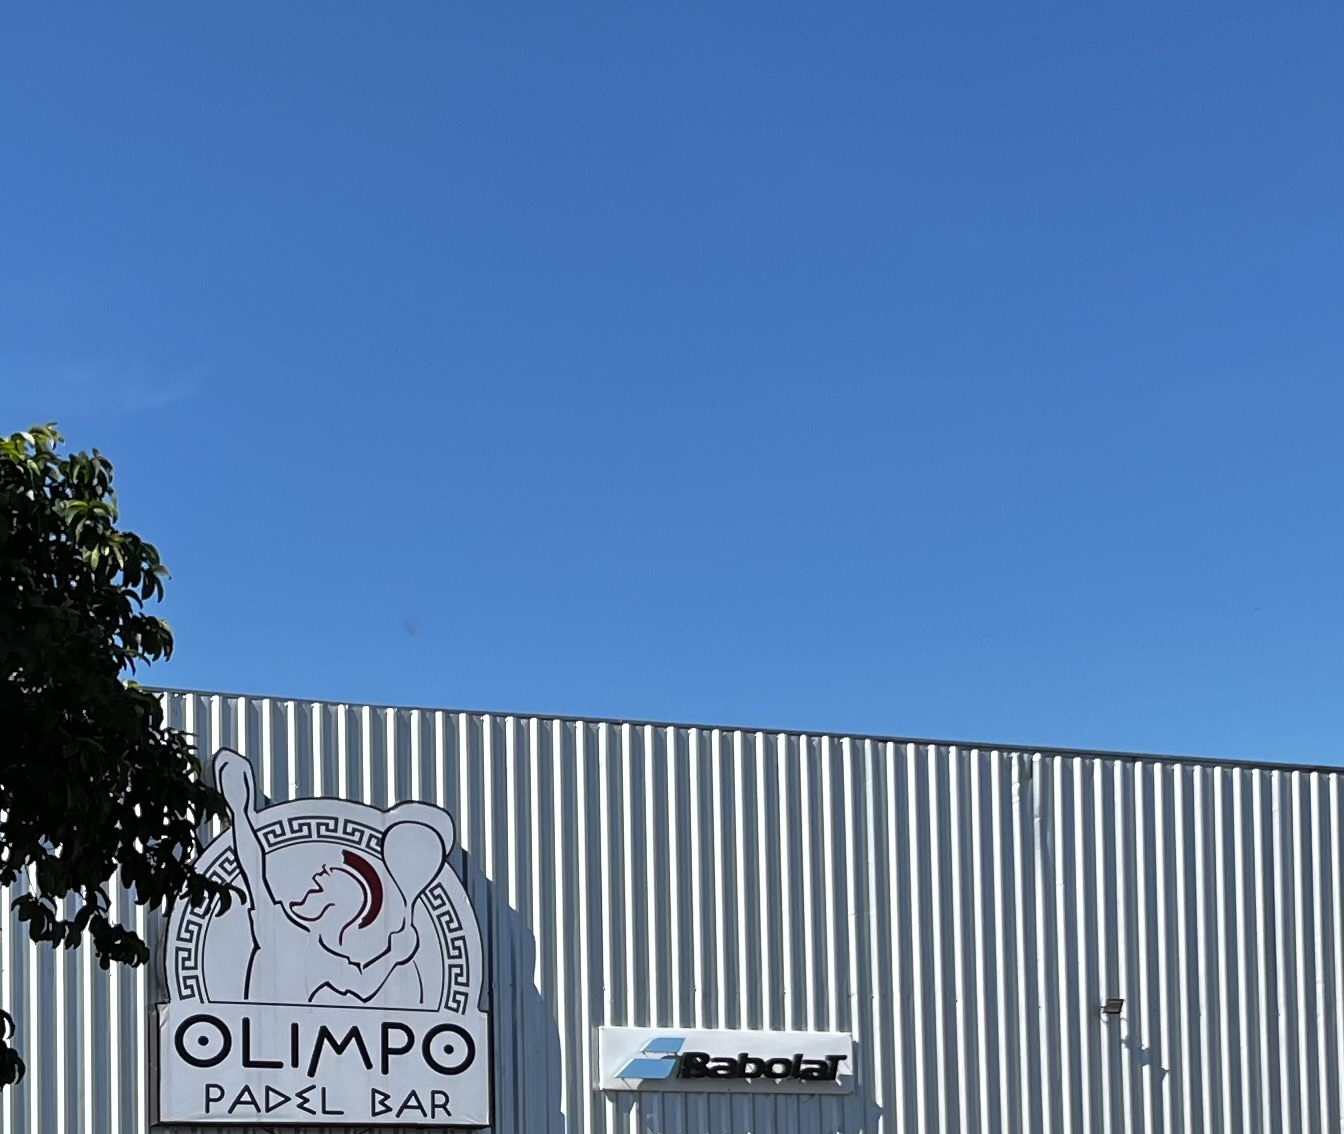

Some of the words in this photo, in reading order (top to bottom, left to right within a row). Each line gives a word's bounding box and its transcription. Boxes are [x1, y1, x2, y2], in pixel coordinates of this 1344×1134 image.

[175, 1013, 476, 1077] OLIMPO
[205, 1083, 345, 1115] PADEL
[371, 1087, 452, 1119] BAR
